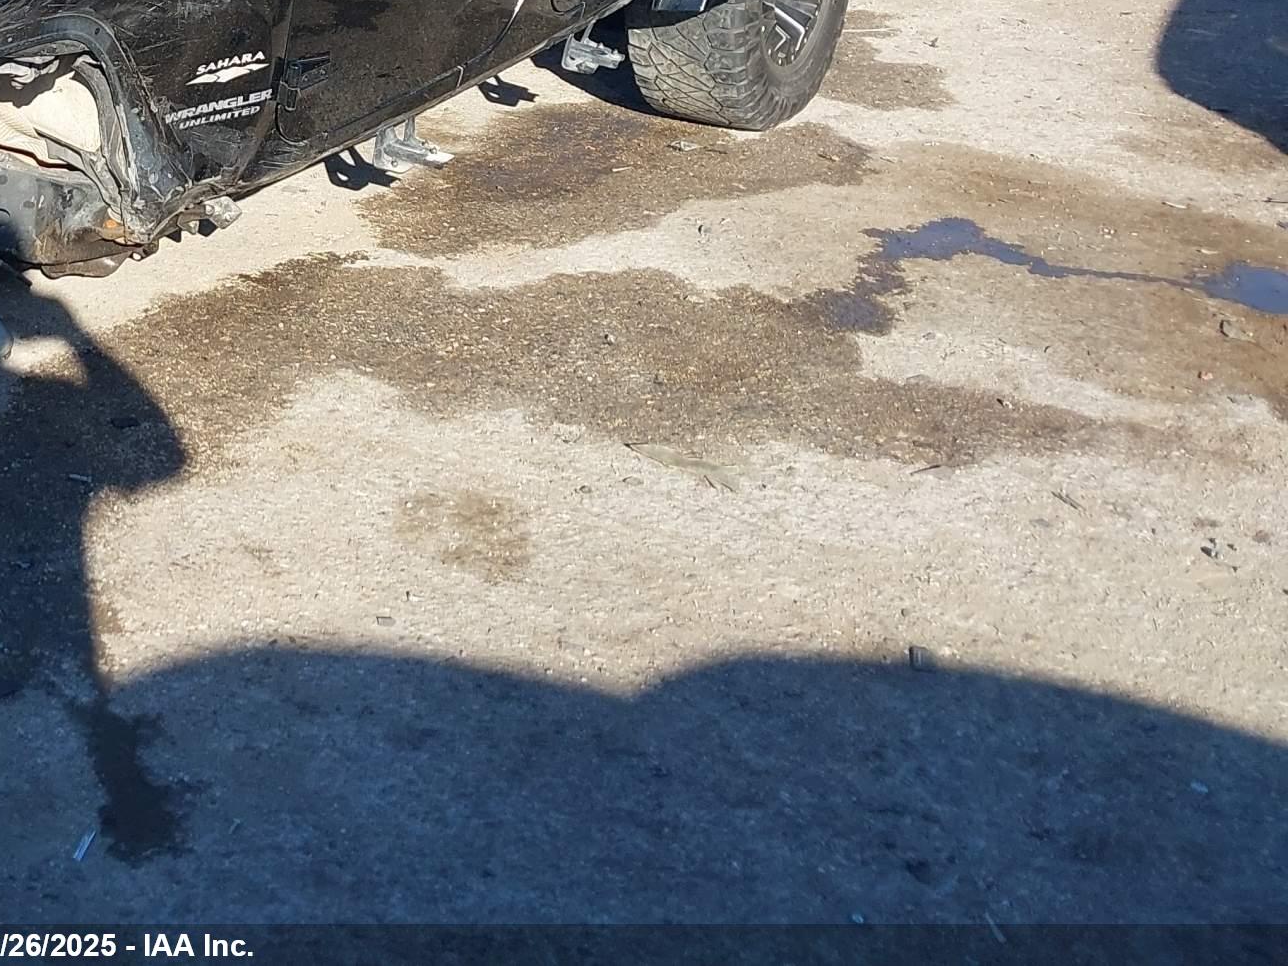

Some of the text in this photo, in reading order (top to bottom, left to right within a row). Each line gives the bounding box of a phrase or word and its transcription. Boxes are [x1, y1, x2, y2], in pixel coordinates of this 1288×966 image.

[195, 50, 266, 75] SAHARA
[165, 88, 273, 125] WRANGLER
[178, 105, 262, 130] UNLIMITED
